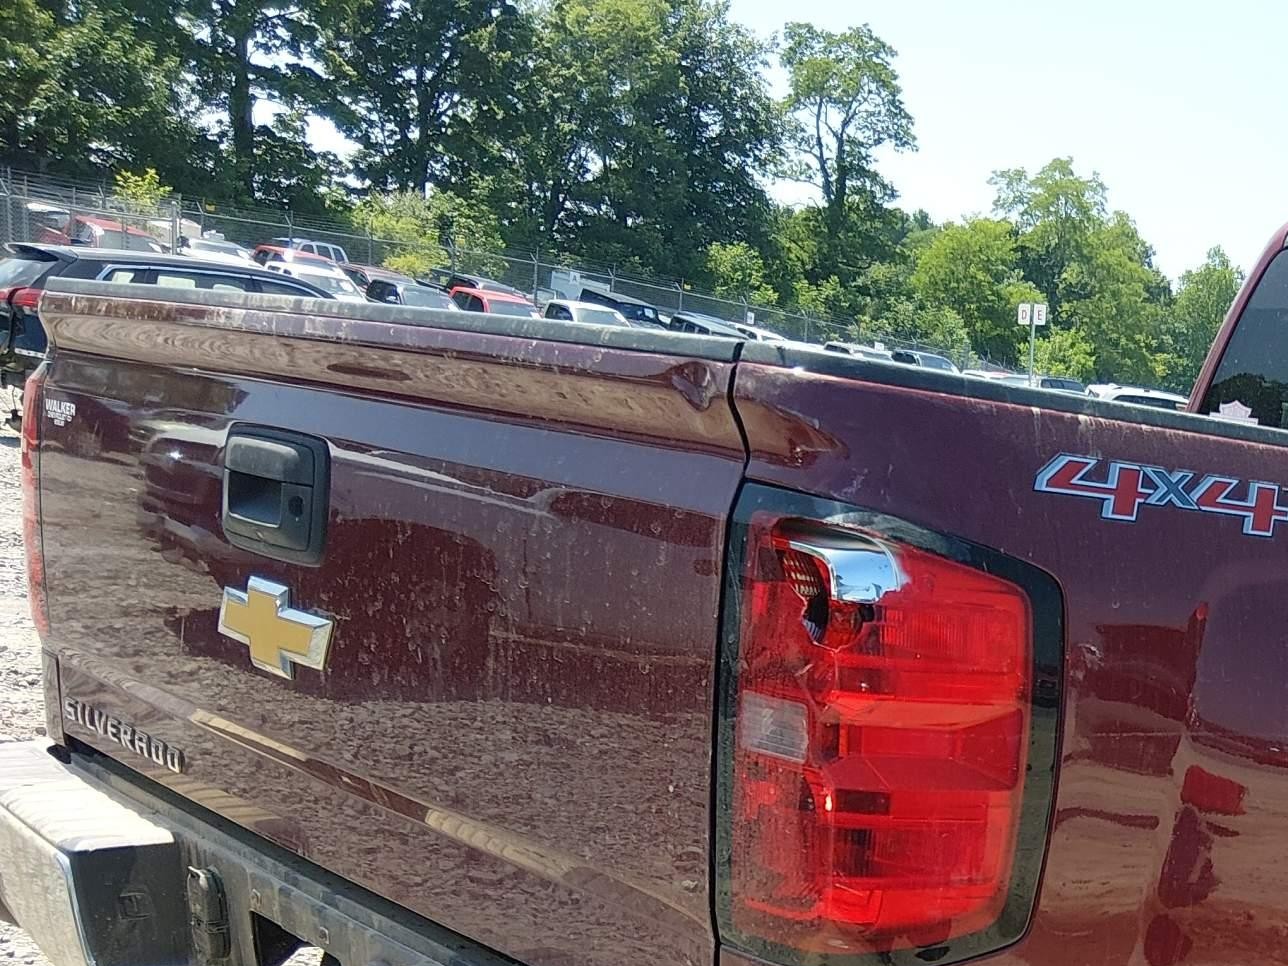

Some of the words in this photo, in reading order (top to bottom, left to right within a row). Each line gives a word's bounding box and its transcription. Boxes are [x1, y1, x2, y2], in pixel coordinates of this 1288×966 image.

[1021, 309, 1028, 321] D
[1037, 309, 1043, 321] E
[45, 399, 76, 417] WALKER
[63, 696, 186, 774] SILVERADO
